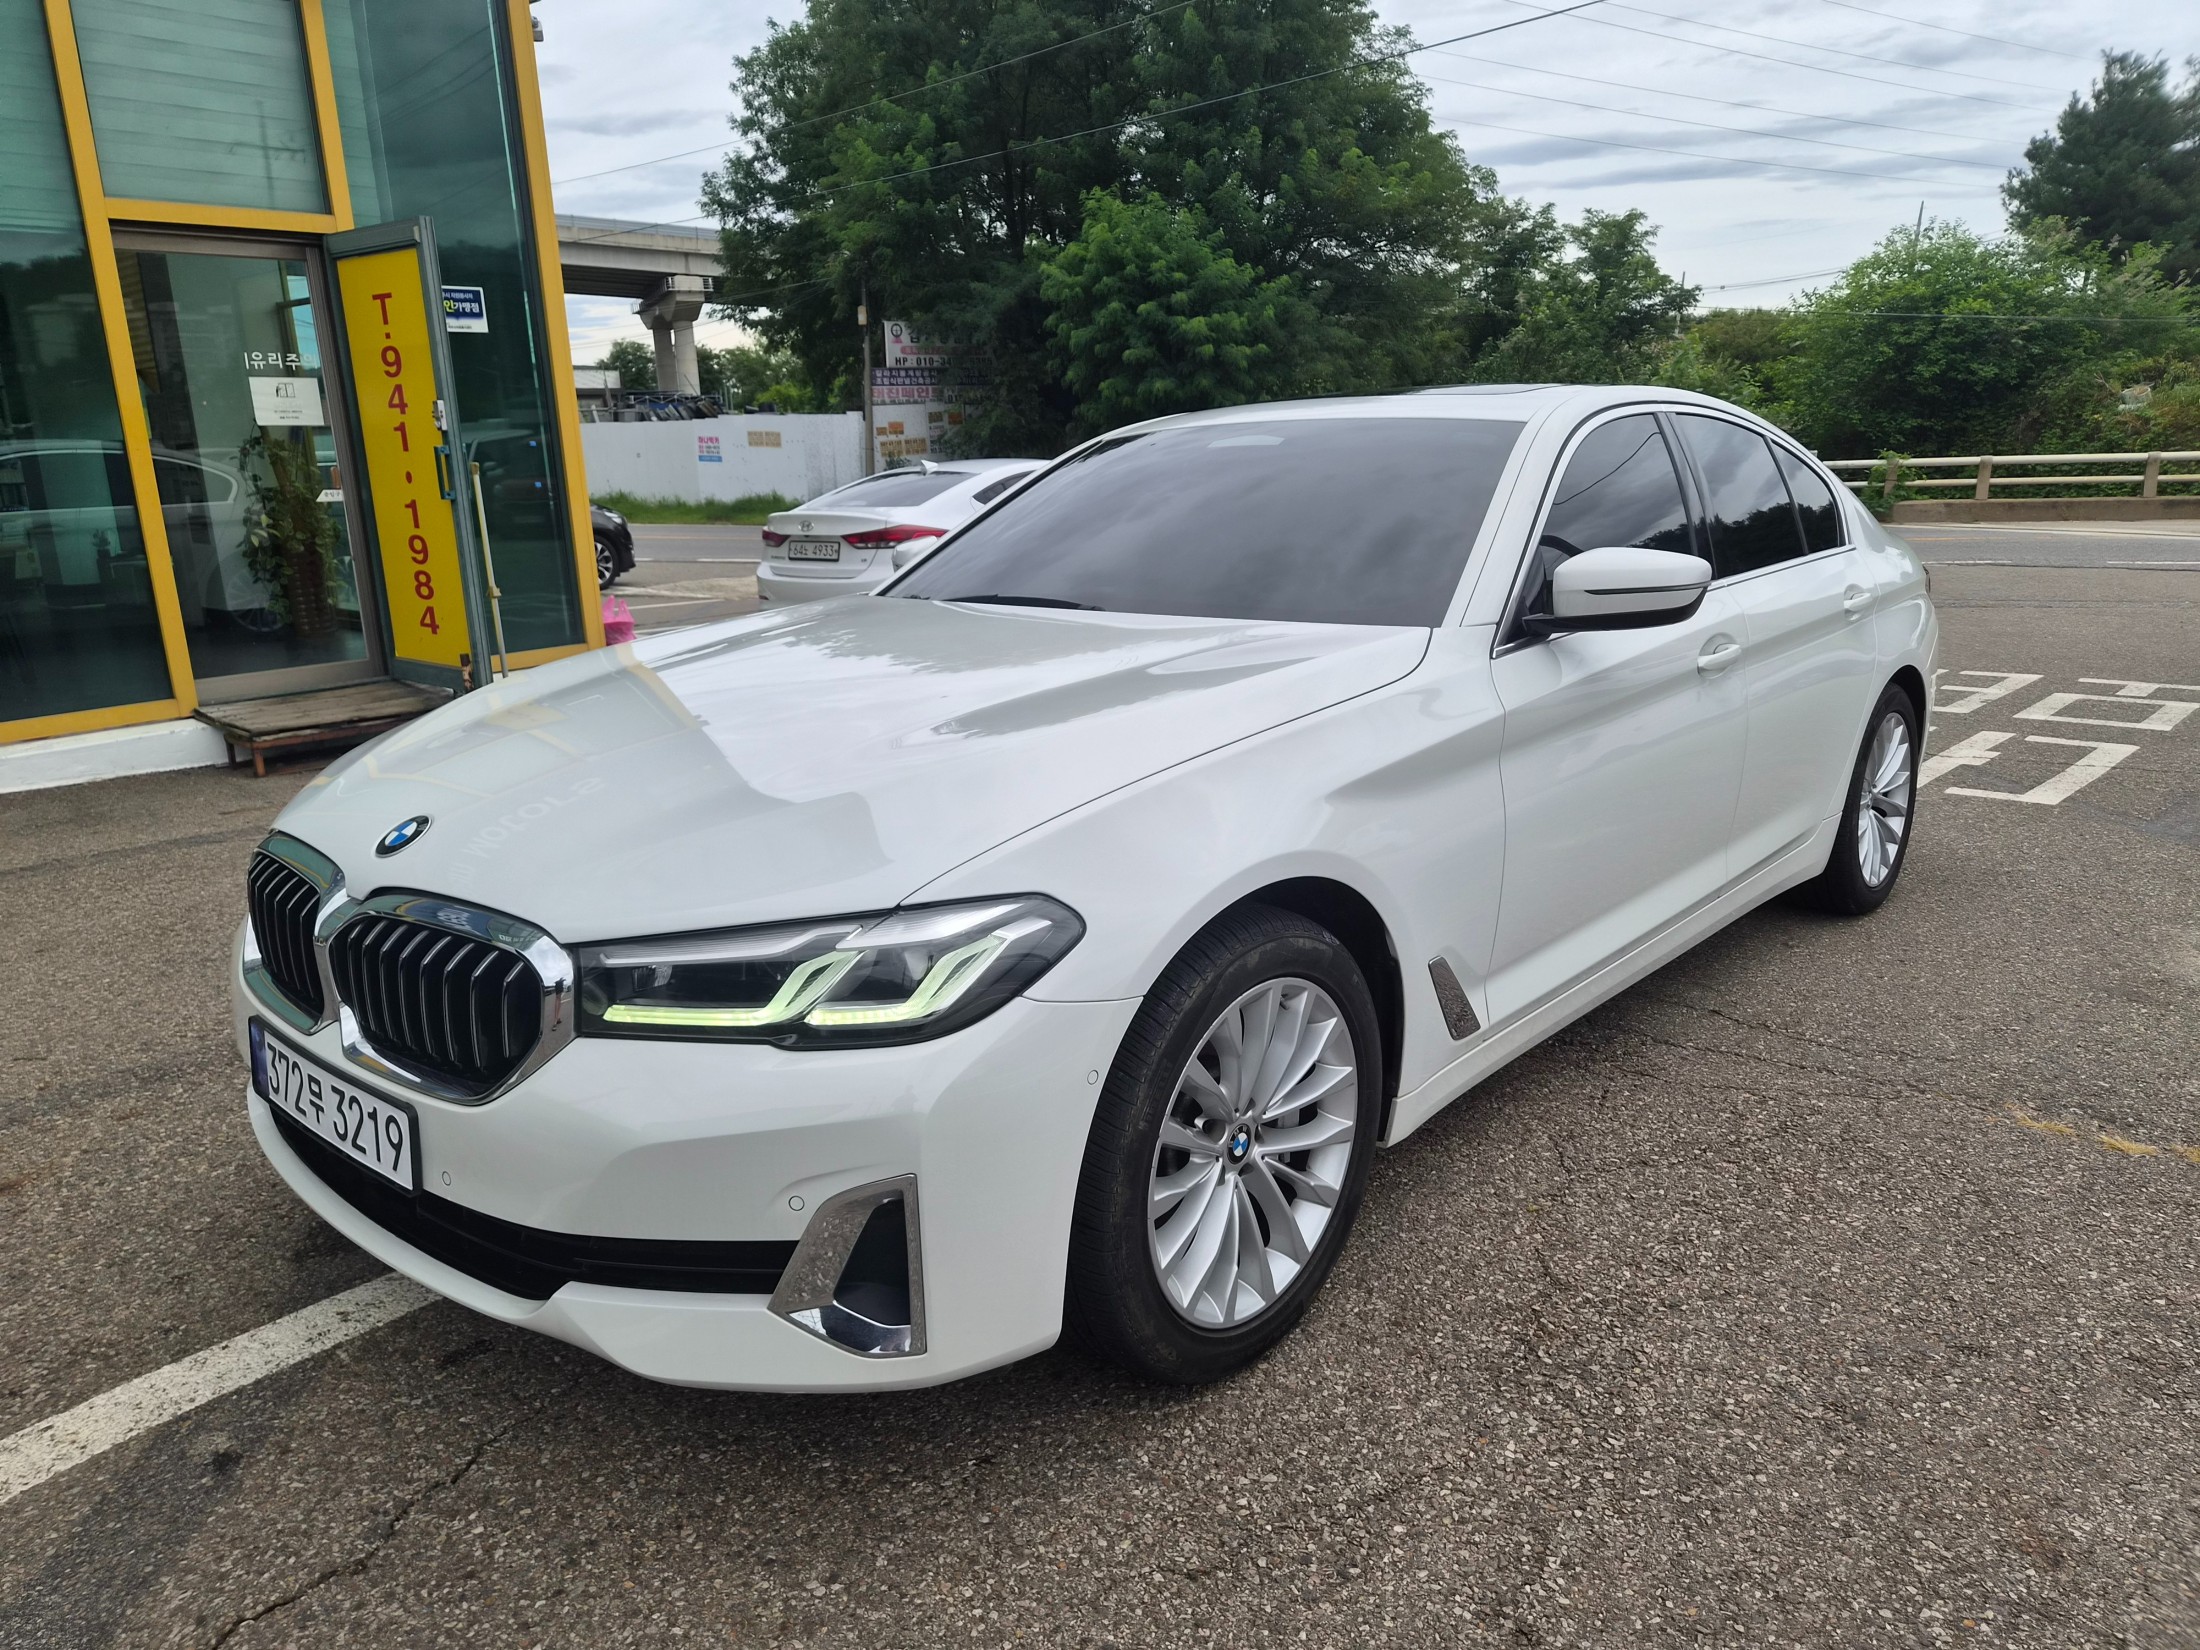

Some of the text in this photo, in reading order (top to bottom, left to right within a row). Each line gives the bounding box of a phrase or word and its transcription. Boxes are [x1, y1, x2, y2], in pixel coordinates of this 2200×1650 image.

[443, 299, 480, 313] 인가맹점
[812, 545, 834, 556] 4933
[267, 1041, 403, 1171] 372무 3219
